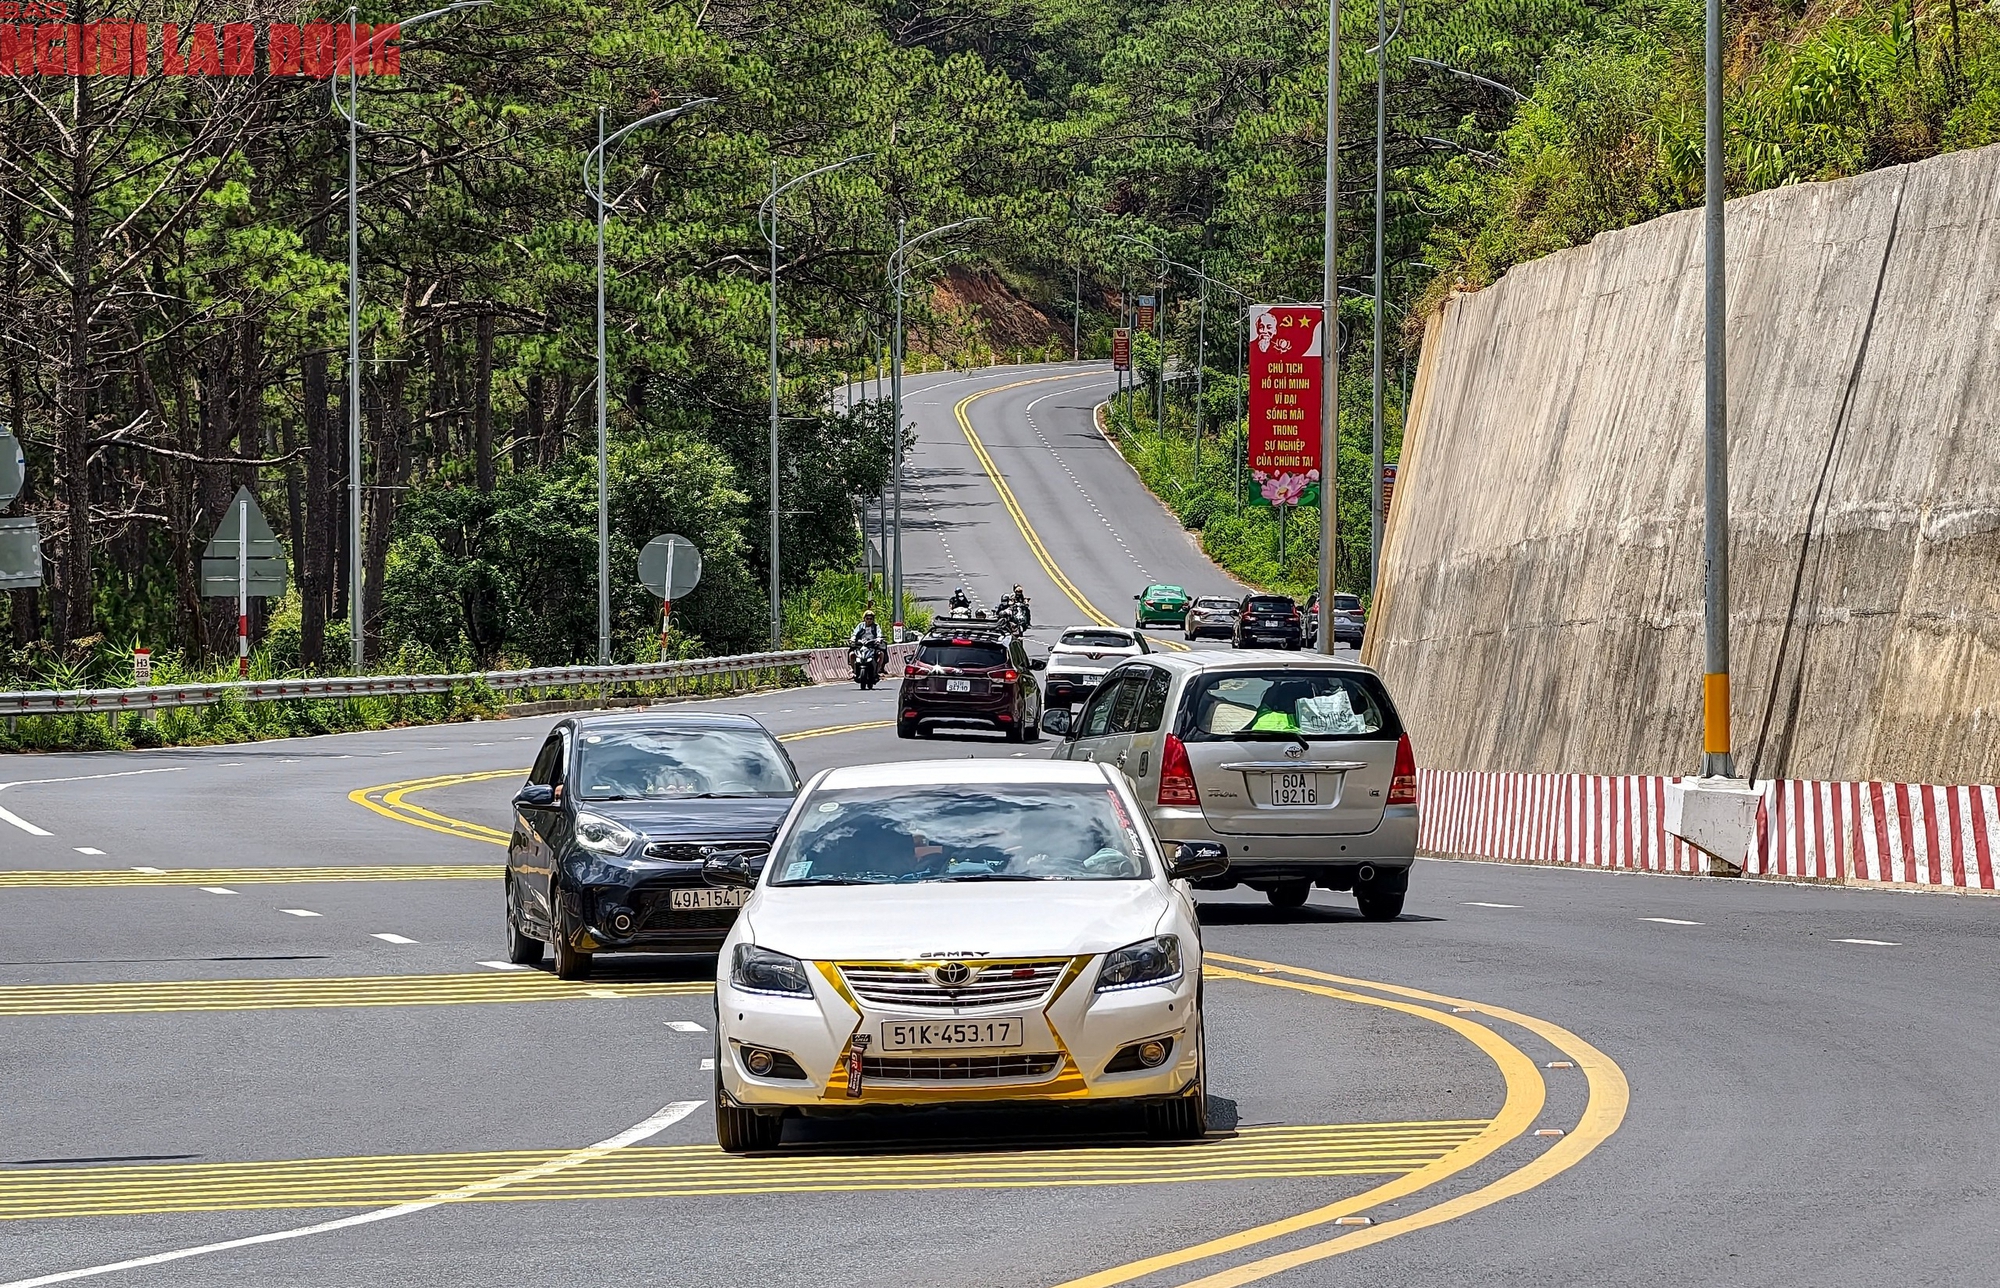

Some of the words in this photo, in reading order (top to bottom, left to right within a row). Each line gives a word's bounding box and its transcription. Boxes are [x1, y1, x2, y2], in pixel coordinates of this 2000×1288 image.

[1268, 359, 1283, 374] CHỦ
[1285, 363, 1303, 376] TỊCH
[1273, 376, 1287, 389] CHÍ
[1289, 378, 1310, 389] MINH
[1266, 405, 1288, 420] SỐNG
[1272, 424, 1298, 436] TRONG
[1265, 439, 1277, 453] SỰ
[1277, 438, 1306, 454] NGHIỆP
[1256, 452, 1272, 466] CỦA
[1274, 453, 1301, 467] CHÚNG
[1301, 456, 1314, 467] TA!
[136, 658, 148, 668] H3
[135, 670, 149, 678] 228
[1282, 774, 1306, 789] 60A
[1274, 789, 1316, 804] 192.16
[894, 1023, 1010, 1045] 51K-453.17
